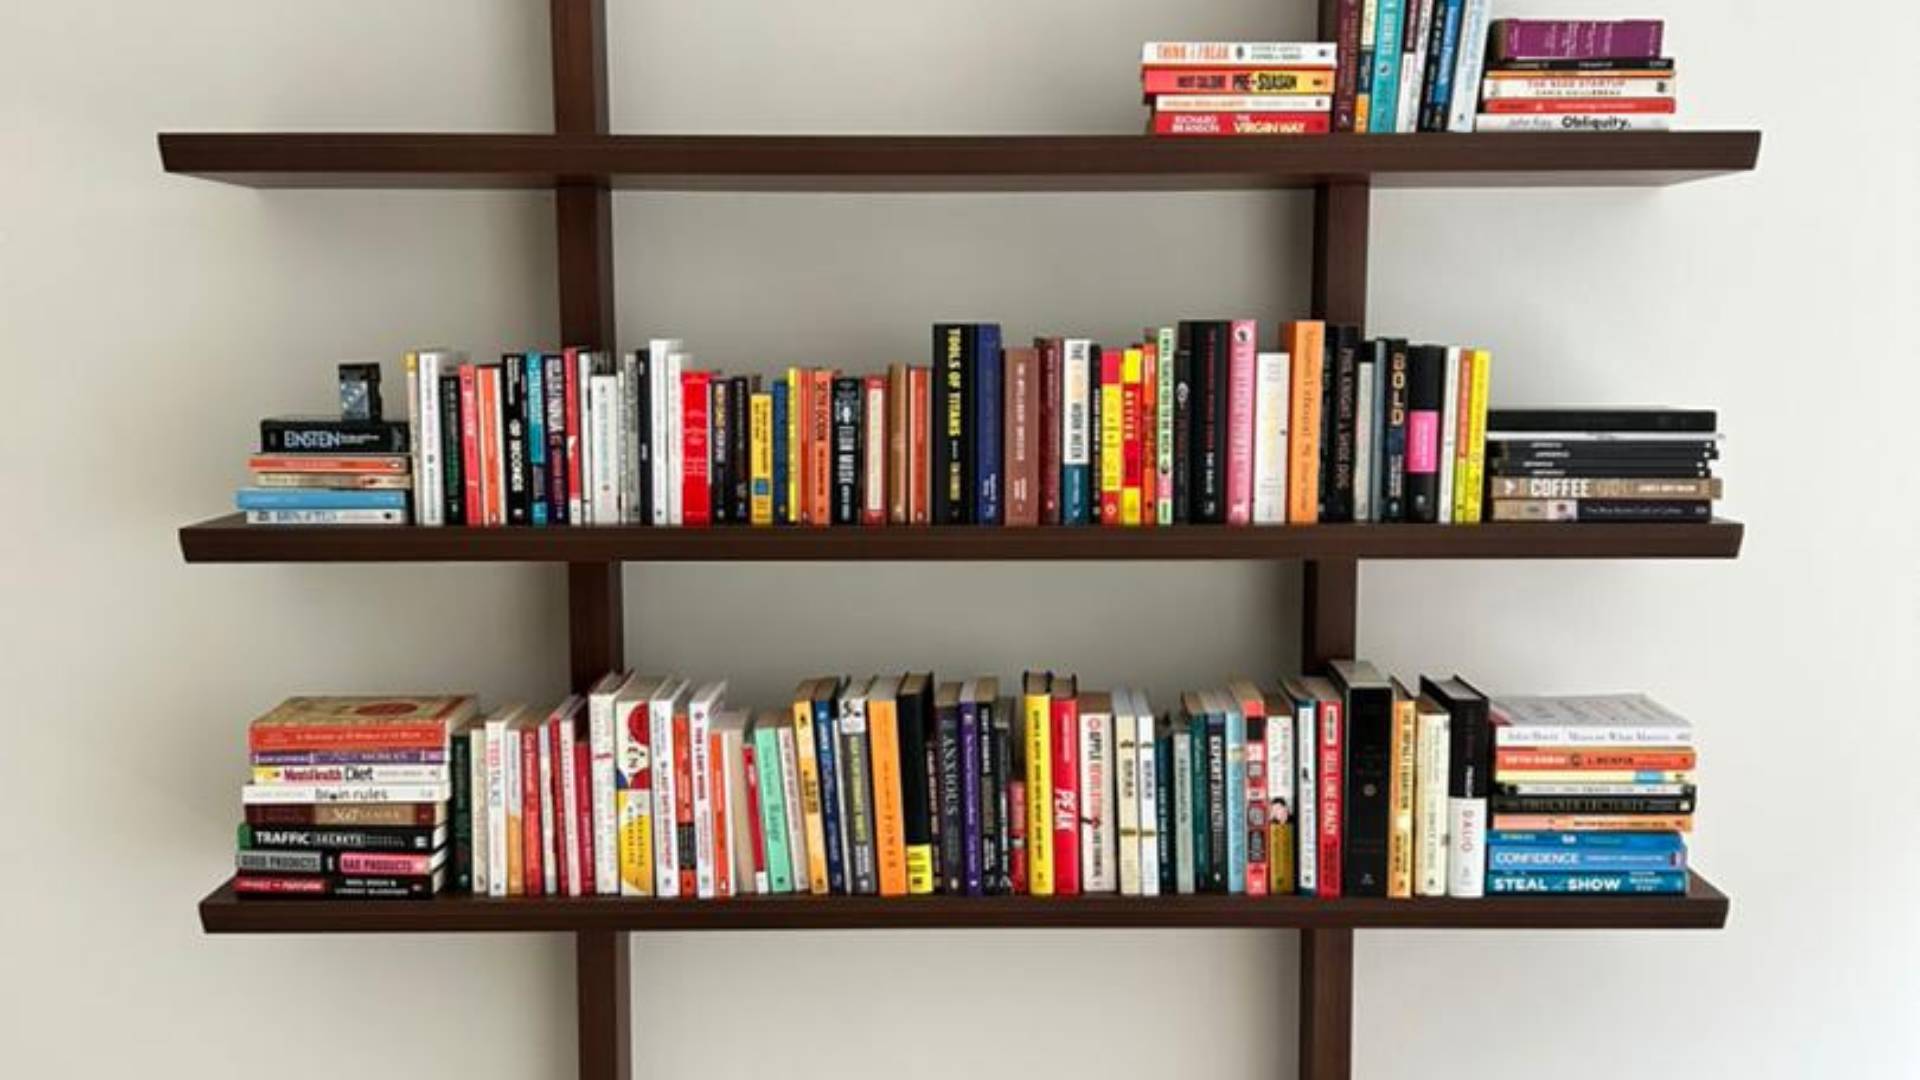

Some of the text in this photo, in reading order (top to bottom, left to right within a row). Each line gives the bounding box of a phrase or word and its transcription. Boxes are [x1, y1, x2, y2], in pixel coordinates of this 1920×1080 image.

[1235, 123, 1276, 133] VIRGIN
[1561, 115, 1632, 130] Obliquity.
[947, 328, 962, 437] TOOLS OF TITANS
[1529, 479, 1593, 498] COFFEE
[1088, 731, 1101, 762] APPLE
[1209, 735, 1223, 781] EXPERT
[345, 766, 373, 782] Diet
[942, 735, 959, 816] ANXIOUS
[1055, 786, 1076, 833] PEAK
[1323, 802, 1338, 836] CRAZY
[256, 832, 313, 846] TRAFFIC
[1460, 809, 1475, 853] DALIO
[1494, 852, 1581, 866] CONFIDENCE
[1493, 879, 1549, 892] STEAL
[1566, 879, 1622, 892] SHOW
